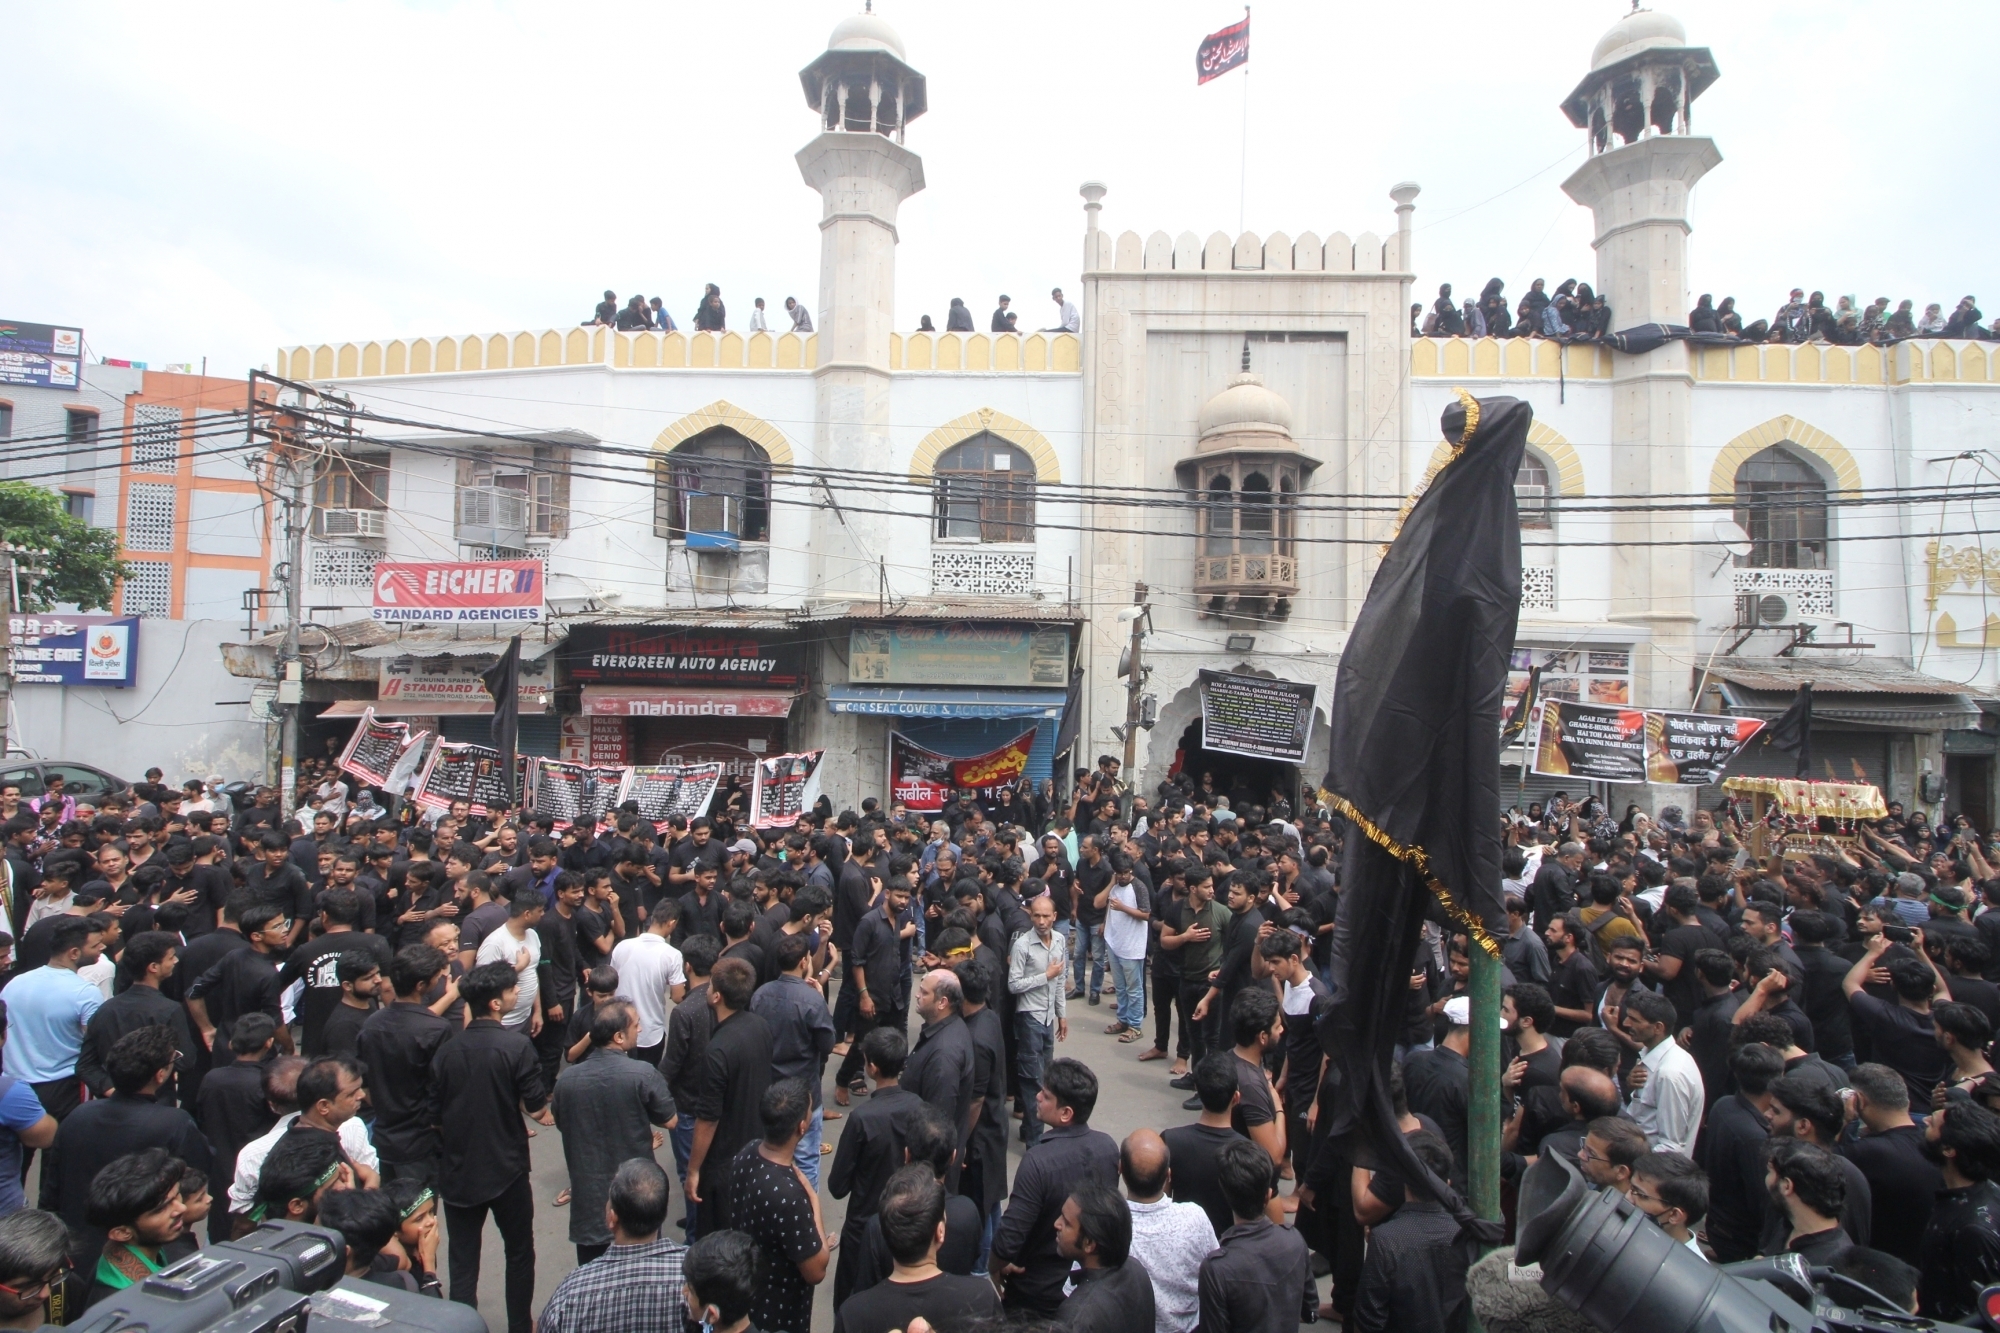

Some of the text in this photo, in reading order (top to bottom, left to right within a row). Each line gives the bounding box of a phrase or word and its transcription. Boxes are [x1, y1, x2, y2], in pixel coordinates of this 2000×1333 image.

[425, 569, 515, 595] EICHER
[373, 608, 538, 620] STANDARD AGENCIES
[608, 631, 759, 657] Mahindra
[55, 648, 82, 662] GATE
[592, 655, 776, 672] EVERGREEN AUTO AGENCY
[403, 683, 473, 692] STANDARD
[1252, 686, 1278, 696] QADEEMI
[1279, 691, 1300, 700] JULOOS
[629, 700, 737, 716] Mahindra
[846, 702, 866, 713] CAR
[869, 703, 897, 714] SEAT
[900, 703, 939, 714] COVER
[942, 704, 950, 715] &
[593, 717, 623, 725] BOLERO
[1569, 720, 1620, 733] GHAM-E-HUSSAIN
[1578, 714, 1625, 726] AGAR DIL MEIN
[1670, 718, 1694, 731] मोहर्रम
[1697, 720, 1721, 733] त्योहार
[592, 734, 622, 742] PICK-UP
[1577, 729, 1590, 737] HAI
[1603, 733, 1625, 741] AANSU
[1670, 733, 1707, 746] आतंकवाद
[1710, 735, 1717, 747] के
[592, 743, 622, 751] VERITO
[1585, 738, 1604, 746] SUNNI
[1605, 740, 1621, 748] NAHI
[592, 752, 620, 760] GENIO
[1670, 748, 1684, 759] एक
[1686, 748, 1712, 760] तहरीक
[307, 966, 316, 987] LET'S
